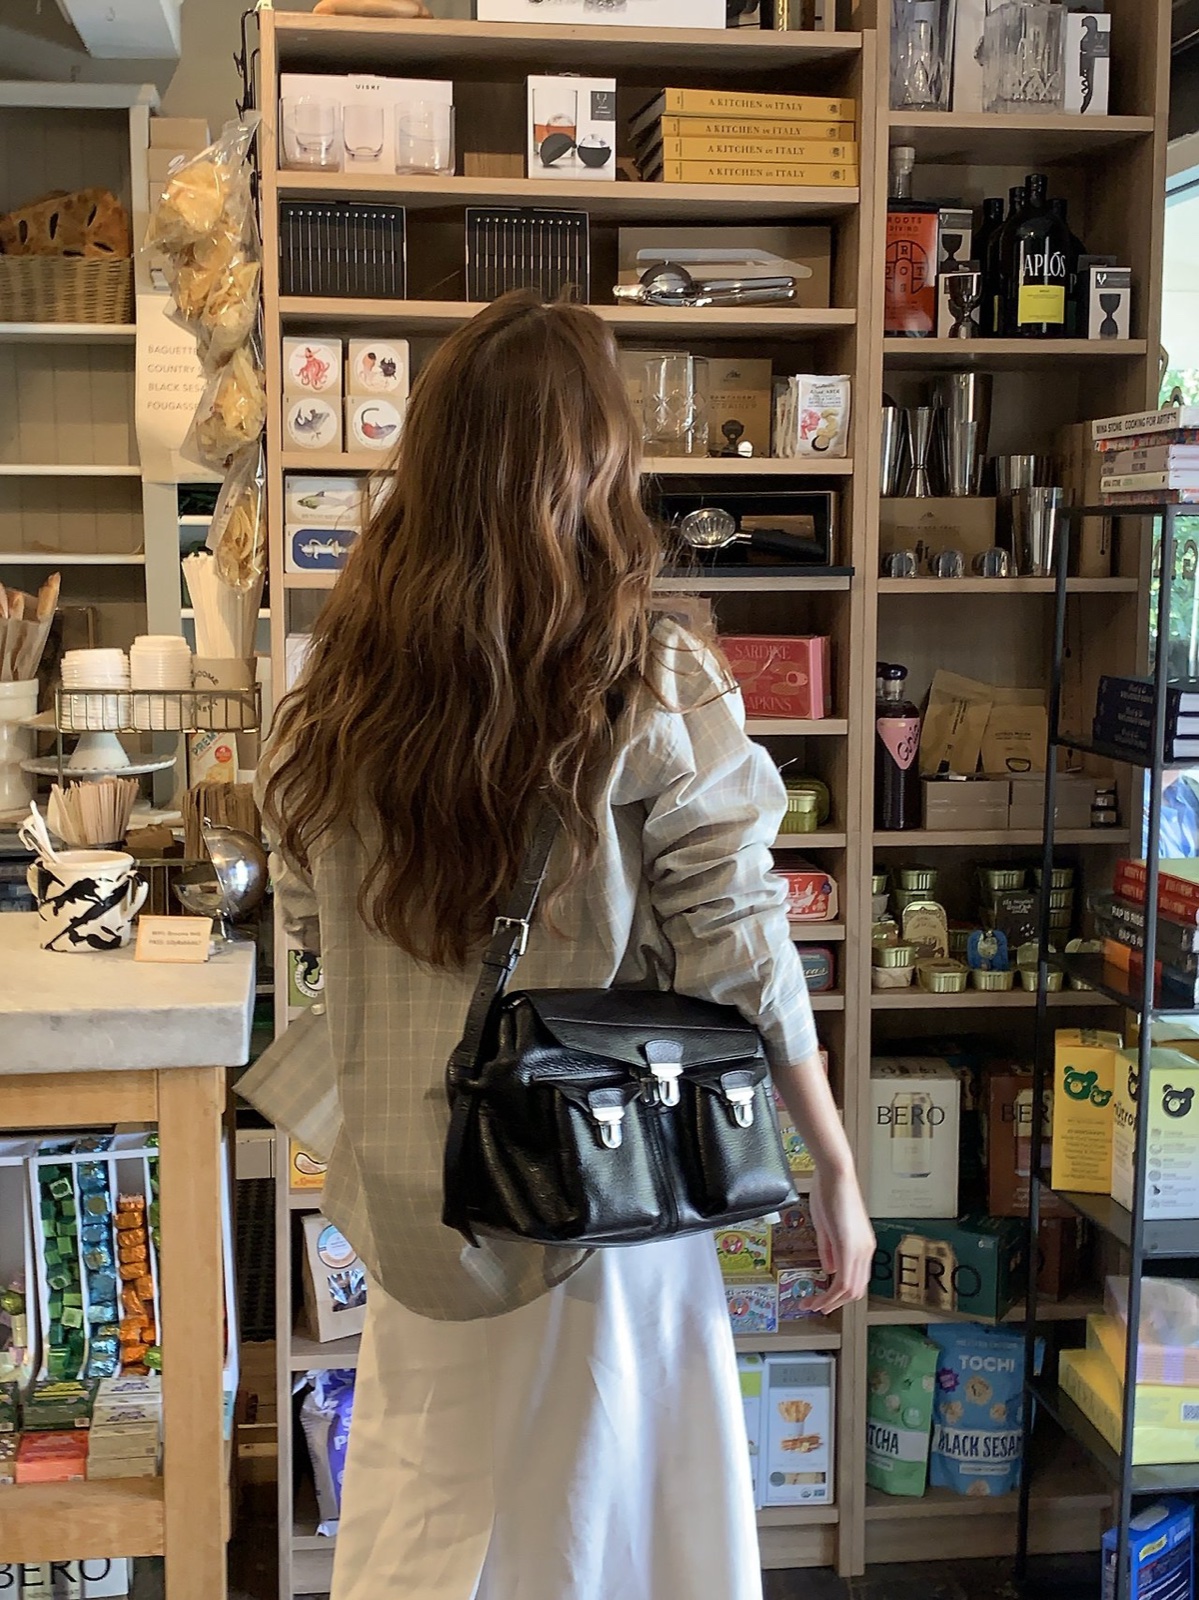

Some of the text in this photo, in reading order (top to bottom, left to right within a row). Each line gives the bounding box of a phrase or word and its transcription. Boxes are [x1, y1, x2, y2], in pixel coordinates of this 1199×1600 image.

[708, 98, 715, 106] A
[717, 98, 762, 109] KITCHEN
[774, 102, 804, 111] ITALY
[706, 124, 712, 132] A
[714, 124, 760, 134] KITCHEN
[772, 127, 802, 135] ITALY
[707, 145, 715, 153] A
[716, 145, 763, 154] KITCHEN
[775, 147, 805, 155] ITALY
[708, 168, 714, 176] A
[716, 168, 763, 177] KITCHEN
[775, 170, 805, 178] ITALY
[901, 246, 908, 254] R
[1023, 251, 1066, 278] APLÓS
[147, 364, 195, 373] COUNTRY
[148, 383, 179, 392] BLACK
[745, 696, 792, 712] APKINS
[877, 1105, 945, 1125] BERO
[873, 1250, 982, 1297] BERO
[958, 1354, 1016, 1373] TOCHI
[867, 1423, 900, 1455] TCHA
[938, 1430, 980, 1457] BLACK
